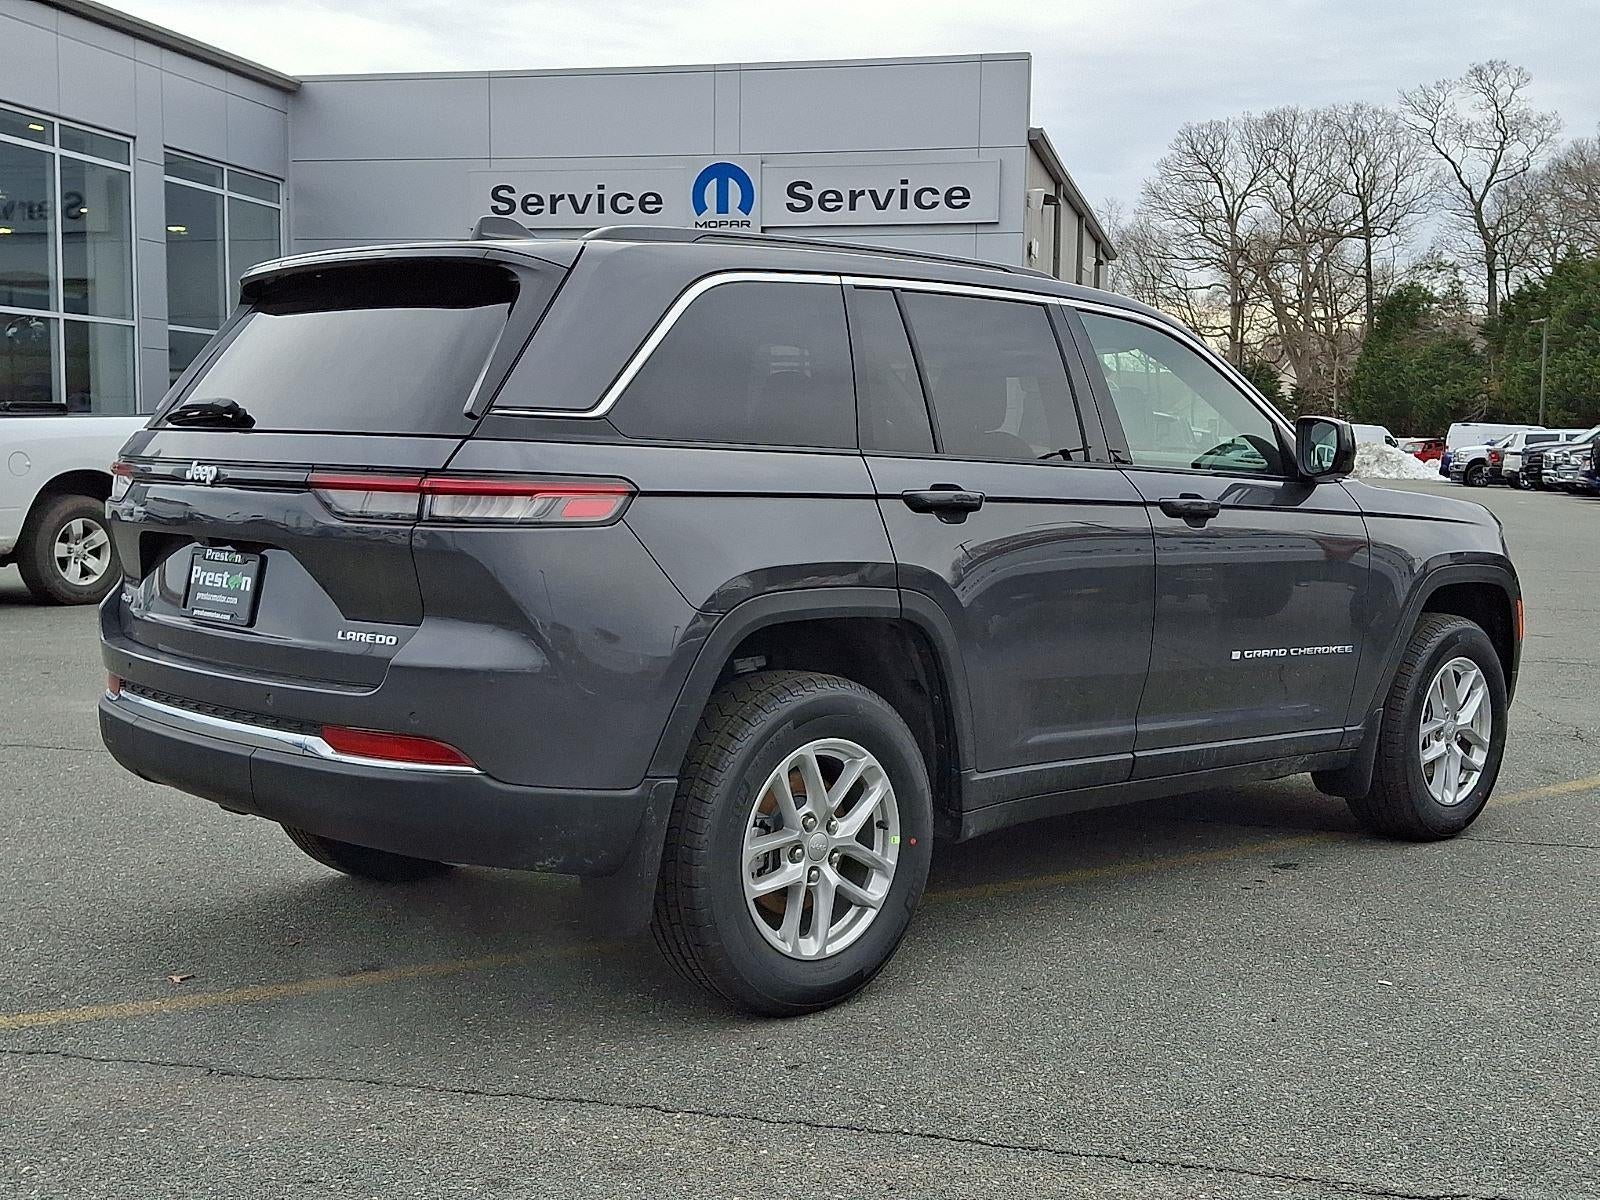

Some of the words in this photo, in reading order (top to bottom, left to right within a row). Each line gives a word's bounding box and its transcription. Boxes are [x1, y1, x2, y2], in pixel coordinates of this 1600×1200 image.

[490, 184, 663, 216] Service
[785, 179, 971, 213] Service
[694, 220, 751, 229] MOPAR
[185, 461, 217, 484] Jeep
[205, 548, 242, 563] Preston
[191, 565, 252, 592] Preston
[336, 629, 399, 646] LAREDO
[1244, 649, 1287, 659] GRAND
[1289, 645, 1353, 656] CHEROKEE
